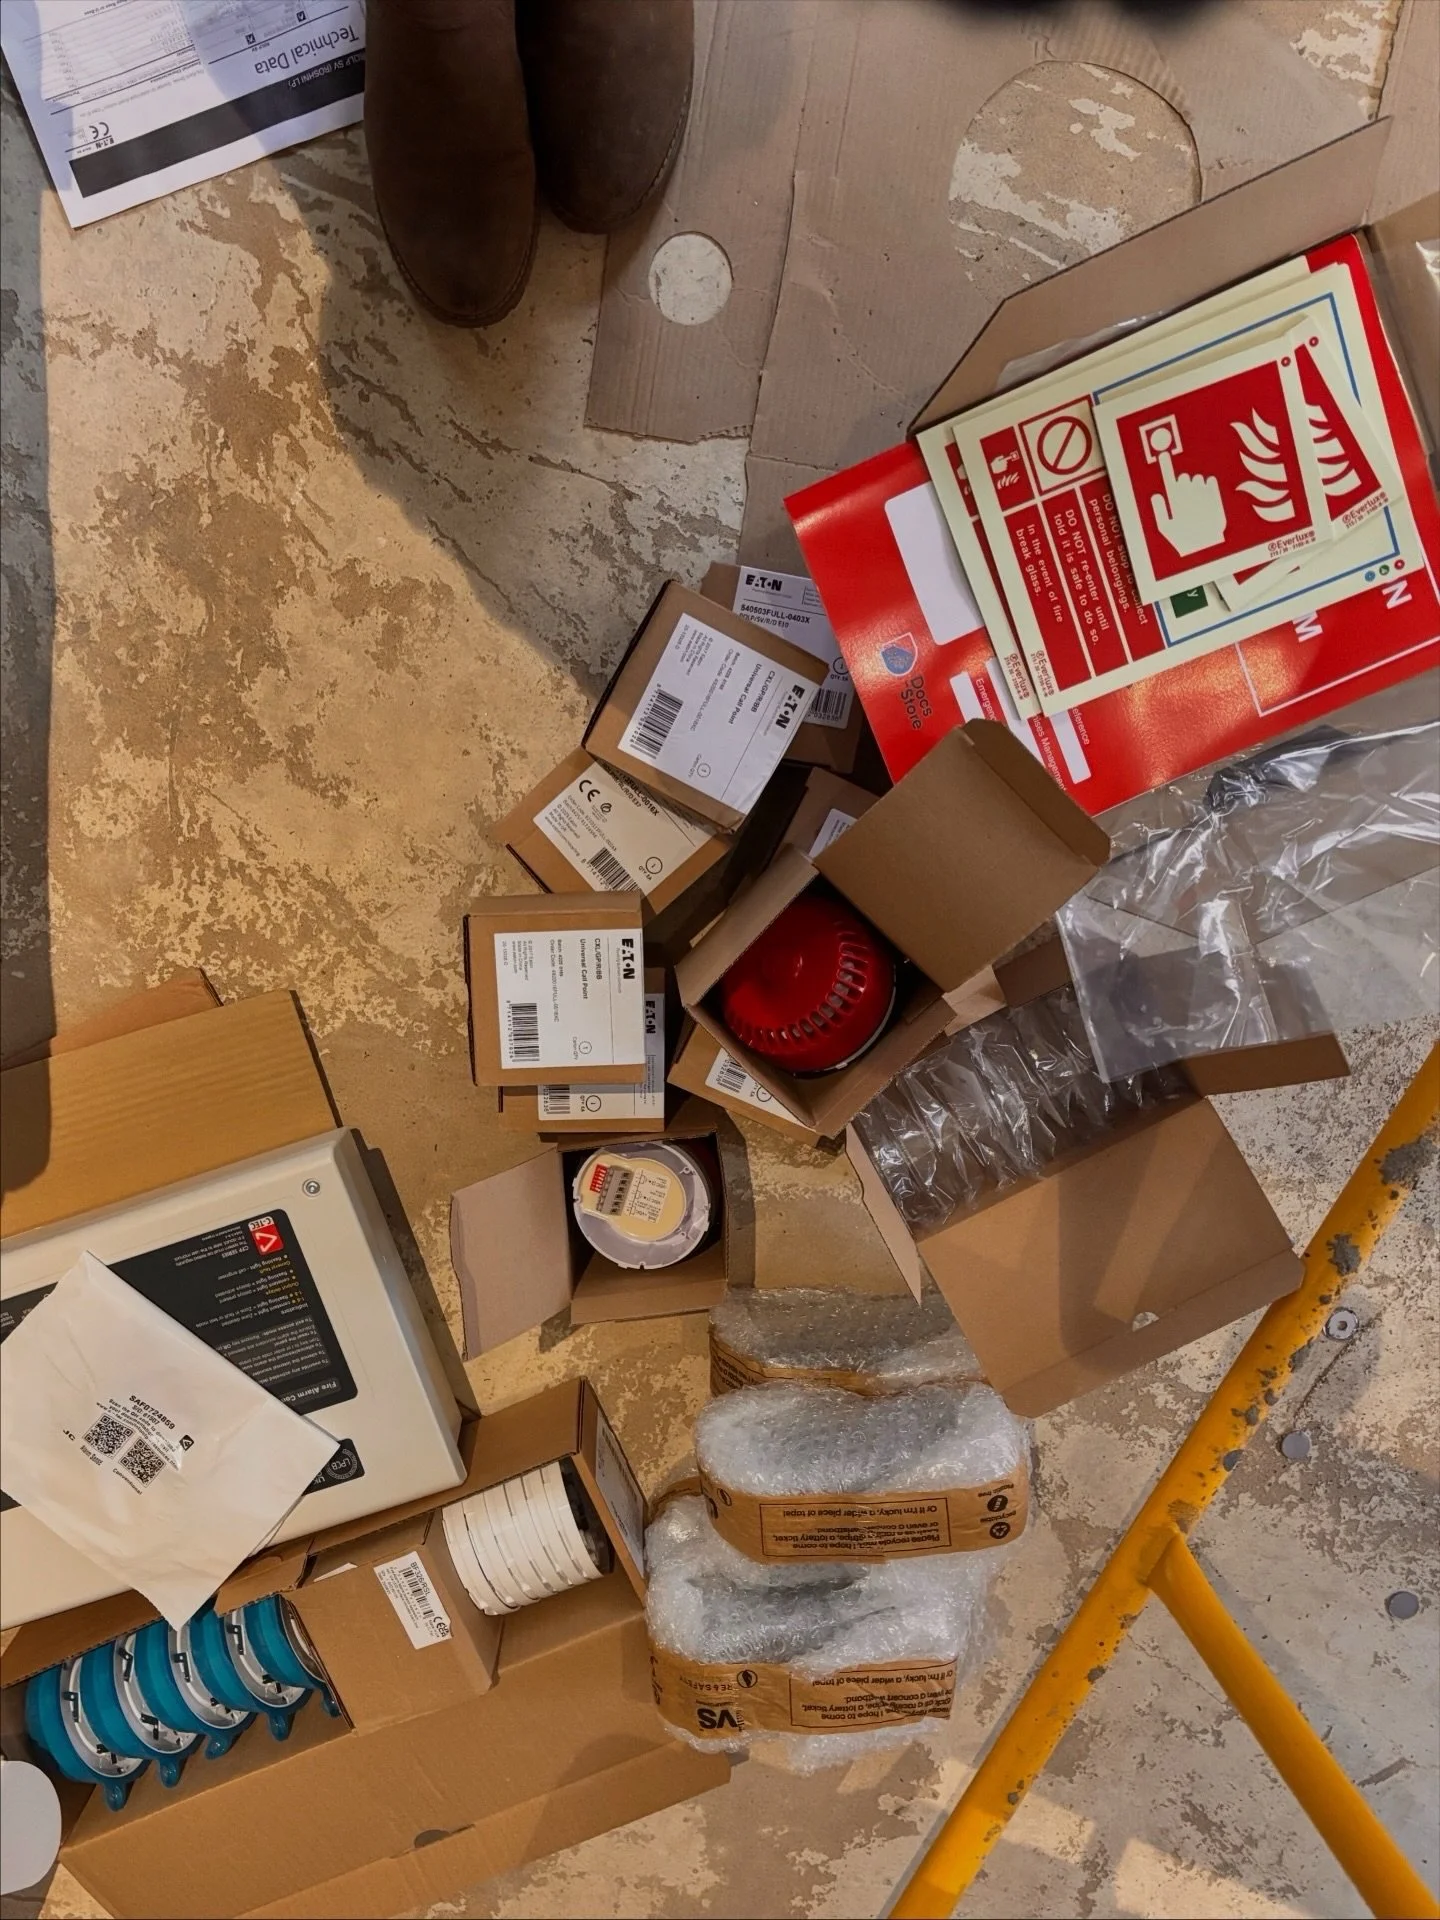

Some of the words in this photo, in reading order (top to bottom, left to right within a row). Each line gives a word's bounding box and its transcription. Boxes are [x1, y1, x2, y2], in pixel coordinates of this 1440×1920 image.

[290, 22, 360, 63] Technical
[253, 51, 290, 79] Data
[1101, 492, 1114, 511] DO
[1026, 523, 1037, 535] In
[1053, 513, 1067, 536] told
[1015, 528, 1032, 560] break
[1030, 537, 1043, 555] the
[1061, 539, 1071, 549] it
[1065, 551, 1076, 563] is
[1087, 497, 1112, 547] personal
[1103, 549, 1132, 613] belongings.
[1037, 558, 1053, 588] event
[1064, 508, 1078, 527] DO
[1071, 530, 1087, 555] NOT
[1080, 559, 1100, 602] re-enter
[1094, 605, 1110, 630] until
[745, 573, 782, 591] EATON
[1022, 562, 1044, 598] glass.
[1069, 566, 1084, 590] safe
[1047, 589, 1058, 602] of
[1078, 593, 1089, 606] to
[1051, 604, 1065, 623] fire
[1082, 609, 1094, 625] do
[1088, 628, 1100, 645] so.
[742, 662, 762, 693] Universal
[749, 670, 776, 712] CXL/GP/R/BB
[911, 675, 934, 717] Docs
[974, 677, 996, 721] Emergenc
[736, 693, 746, 707] Call
[774, 684, 805, 729] EATON
[727, 706, 740, 724] Point
[899, 687, 924, 731] Store
[1070, 704, 1091, 746] eference
[575, 776, 601, 802] CE
[621, 938, 634, 979] EATON
[645, 1000, 655, 1033] EATON
[249, 1217, 271, 1230] C-TEC
[296, 1386, 320, 1398] Alarm
[320, 1380, 336, 1391] Fire
[330, 1457, 351, 1470] LPCB
[110, 1467, 145, 1495] Conventional
[783, 1508, 805, 1518] tape!
[806, 1509, 815, 1517] of
[817, 1508, 841, 1518] piece
[876, 1507, 901, 1517] lucky,
[792, 1542, 817, 1550] come
[829, 1541, 851, 1550] hope
[877, 1536, 909, 1545] recycle
[910, 1534, 939, 1543] Please
[835, 1677, 844, 1685] of
[845, 1675, 869, 1685] piece
[871, 1676, 893, 1684] wider
[903, 1673, 926, 1682] lucky,
[887, 1692, 918, 1701] concert
[820, 1712, 845, 1720] come
[828, 1703, 855, 1713] lottery
[857, 1710, 878, 1718] hope
